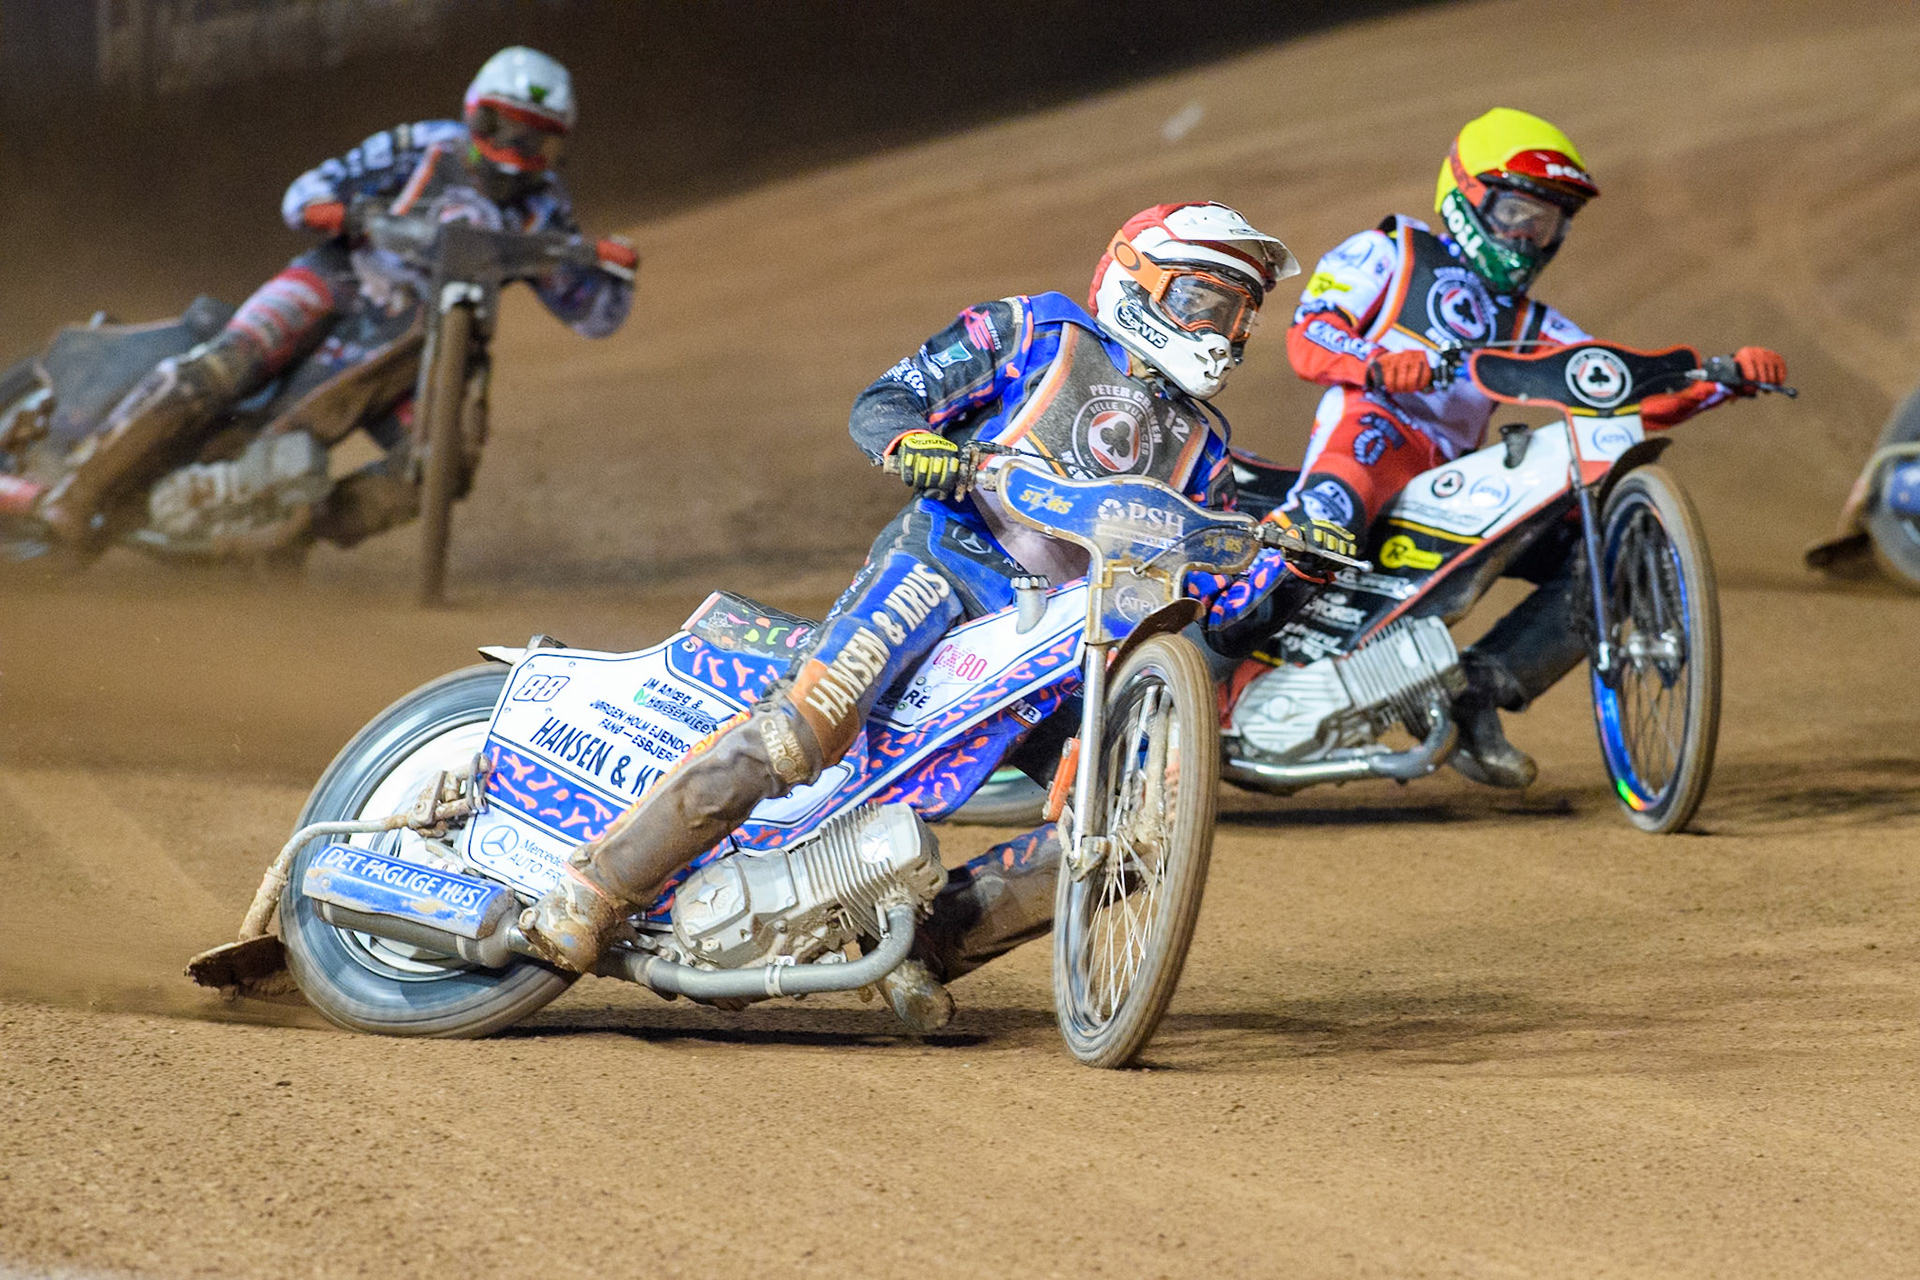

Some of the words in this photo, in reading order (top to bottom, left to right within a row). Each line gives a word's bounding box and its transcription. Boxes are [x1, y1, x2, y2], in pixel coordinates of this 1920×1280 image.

[1089, 383, 1131, 397] PETER
[1089, 401, 1119, 415] BELLE
[1164, 406, 1191, 444] 12
[1128, 502, 1186, 537] PSH
[883, 563, 950, 632] KRUS
[871, 611, 908, 646] &
[511, 674, 571, 702] 88
[805, 626, 890, 727] HANSEN
[691, 699, 703, 710] &
[623, 713, 651, 732] HOLM
[530, 716, 613, 777] HANSEN
[610, 755, 633, 789] &
[509, 853, 543, 873] AUTO
[520, 839, 565, 868] Mercede
[323, 849, 367, 872] DET
[360, 859, 441, 896] FAGLIGE
[437, 883, 481, 907] HUS
